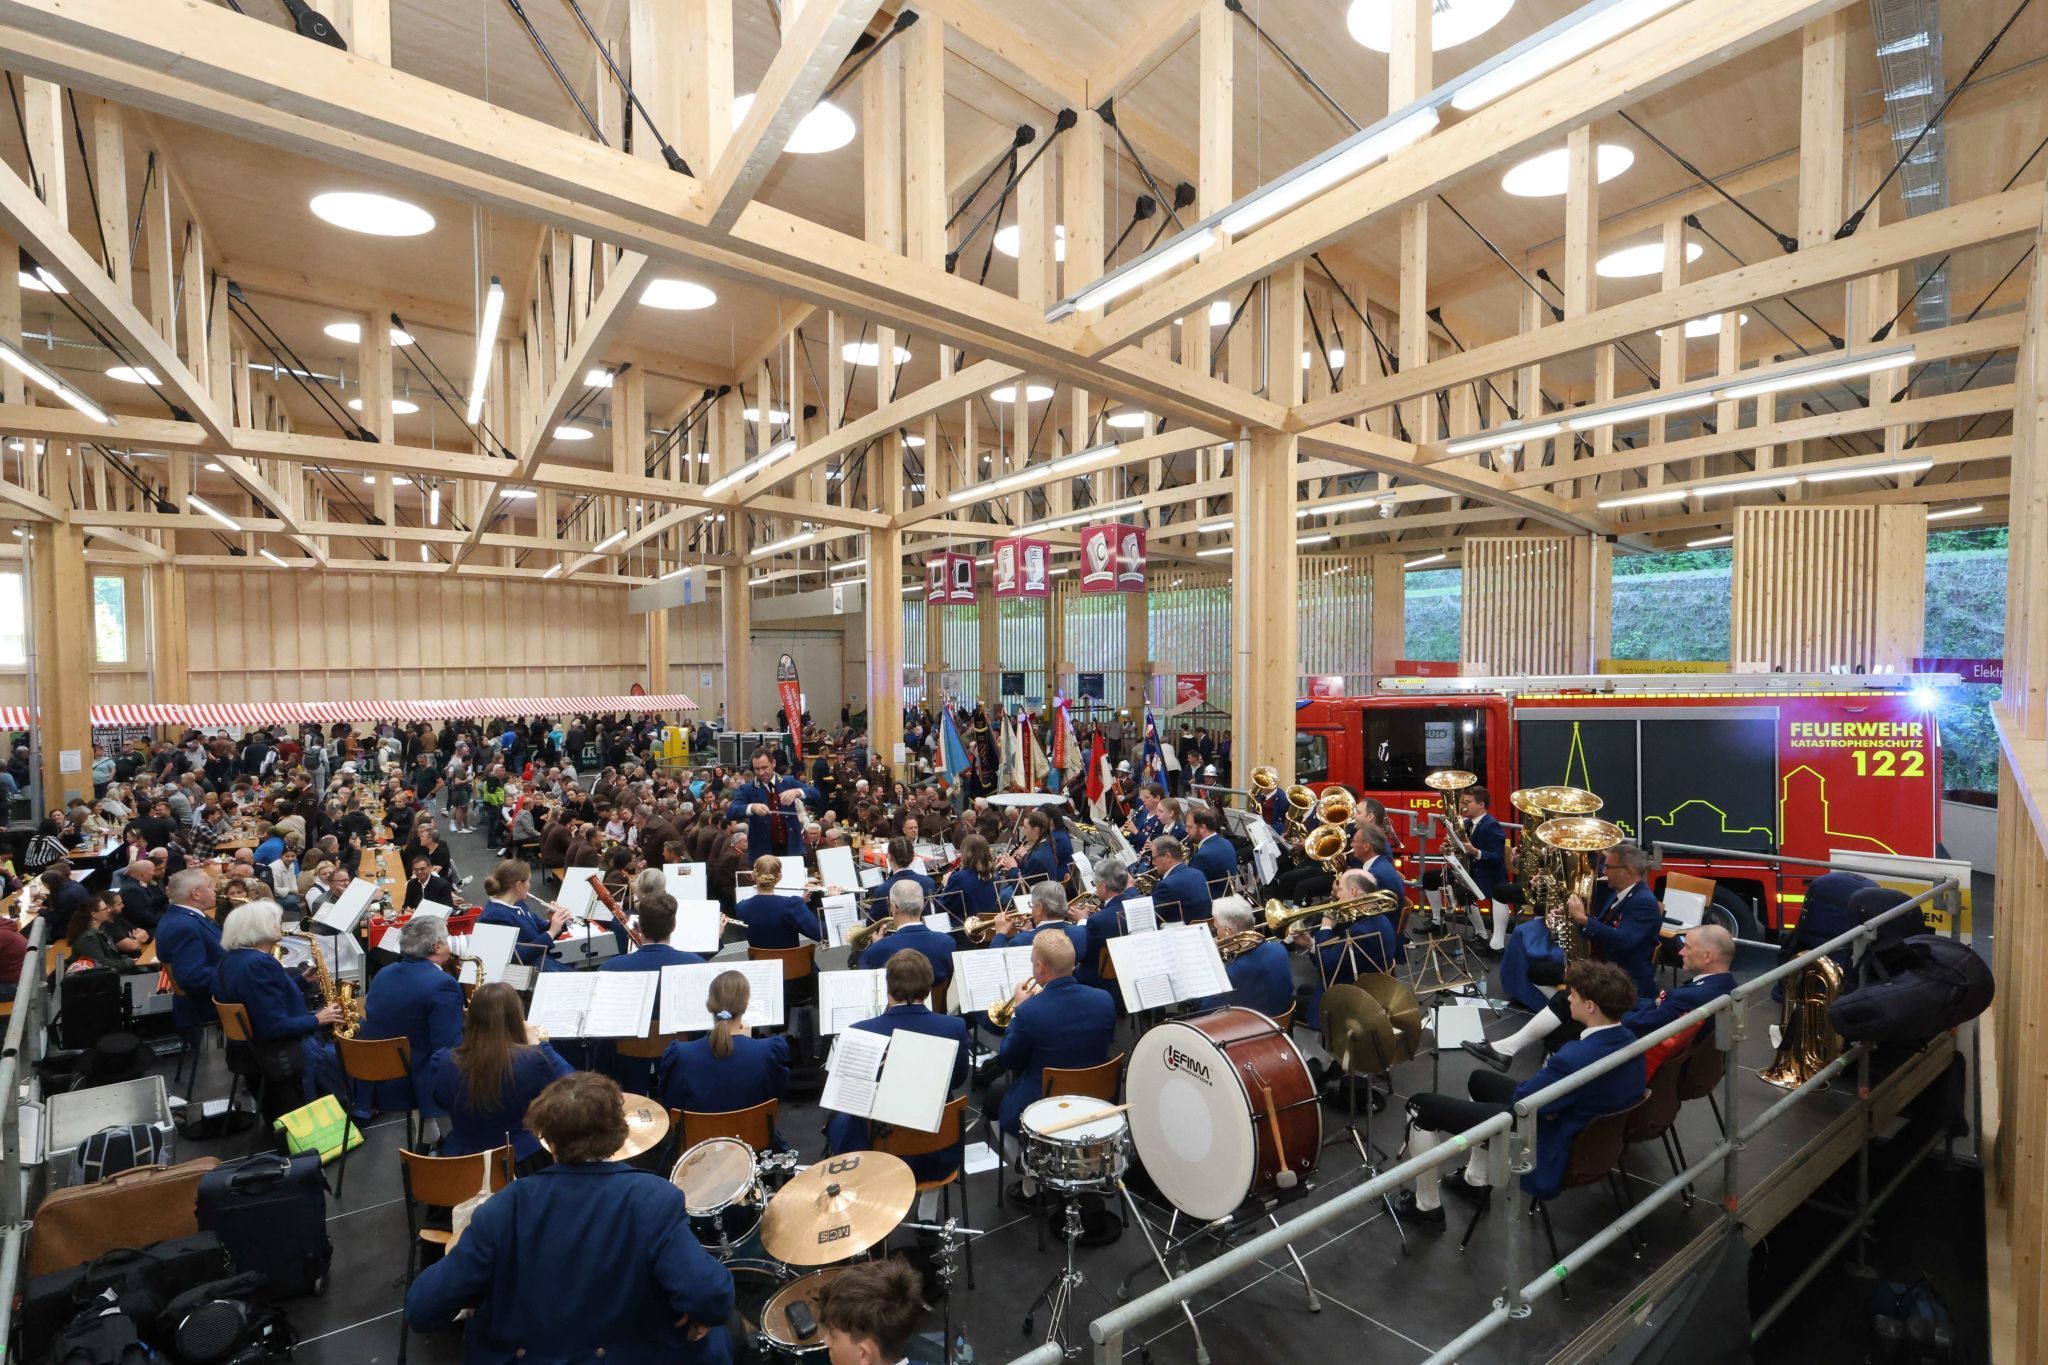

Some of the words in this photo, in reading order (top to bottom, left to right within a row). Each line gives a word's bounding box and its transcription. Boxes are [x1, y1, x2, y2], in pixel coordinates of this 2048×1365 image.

[1790, 722, 1923, 737] FEUERWEHR
[1791, 739, 1923, 748] KATASTROPHENSCHUTZ
[1851, 750, 1925, 777] 122
[819, 1226, 849, 1244] MCS
